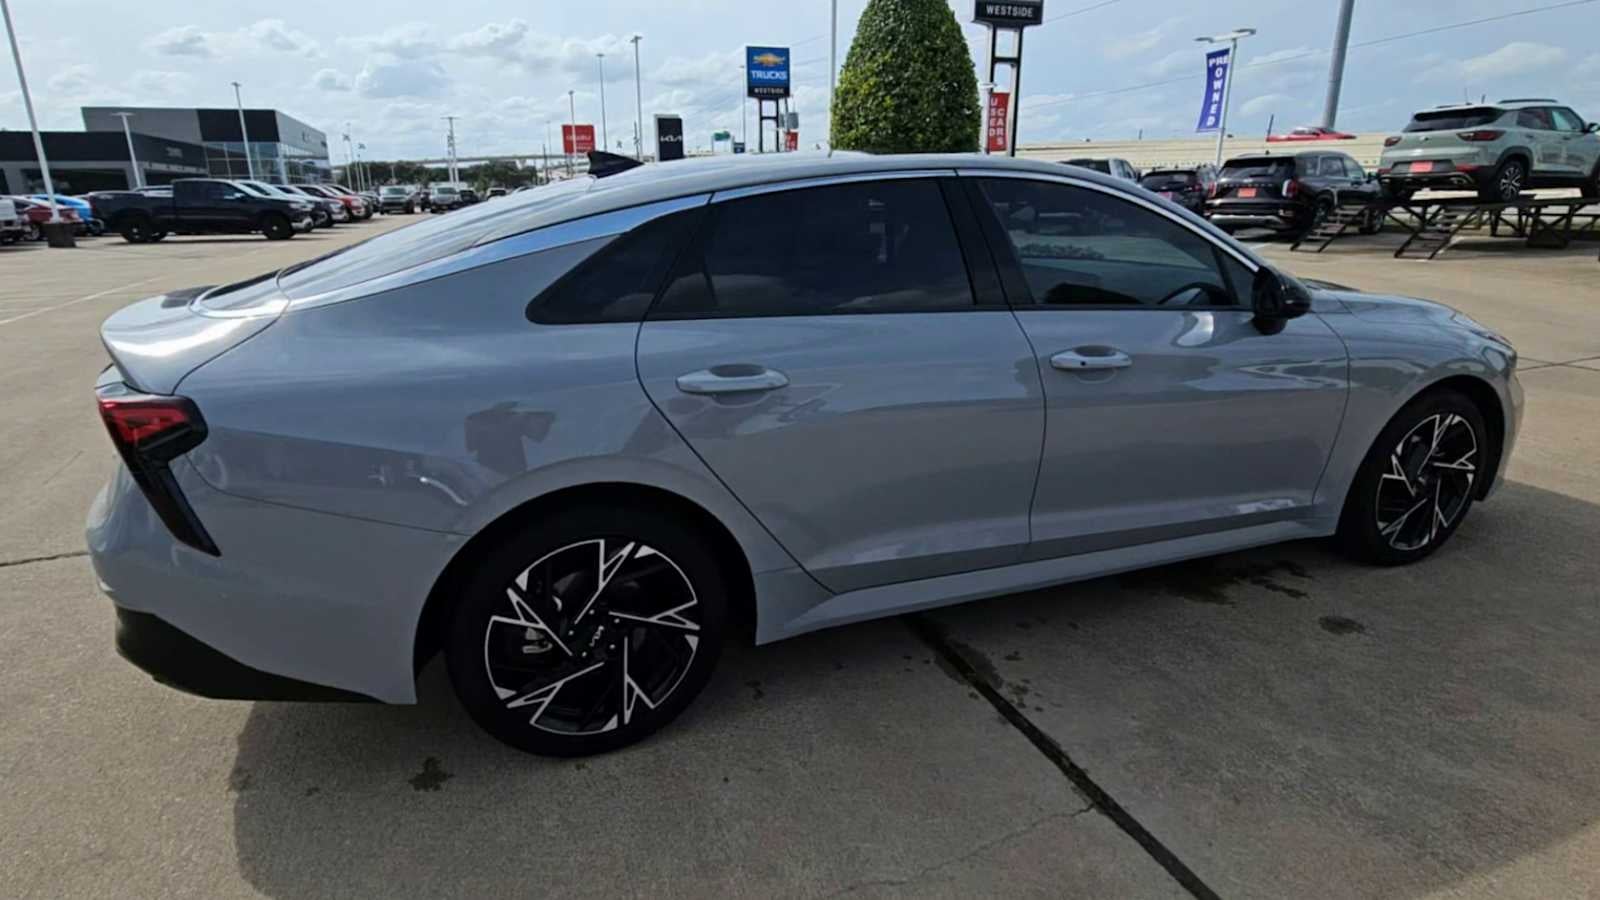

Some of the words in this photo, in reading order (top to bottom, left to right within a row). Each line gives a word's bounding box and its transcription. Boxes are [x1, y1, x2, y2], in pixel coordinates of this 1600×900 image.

[986, 4, 1033, 17] WESTSIDE
[1209, 54, 1231, 67] PRE
[752, 69, 787, 80] TRUCKS
[1206, 66, 1223, 127] OWNED
[989, 96, 998, 137] USED
[996, 107, 1006, 145] CARS
